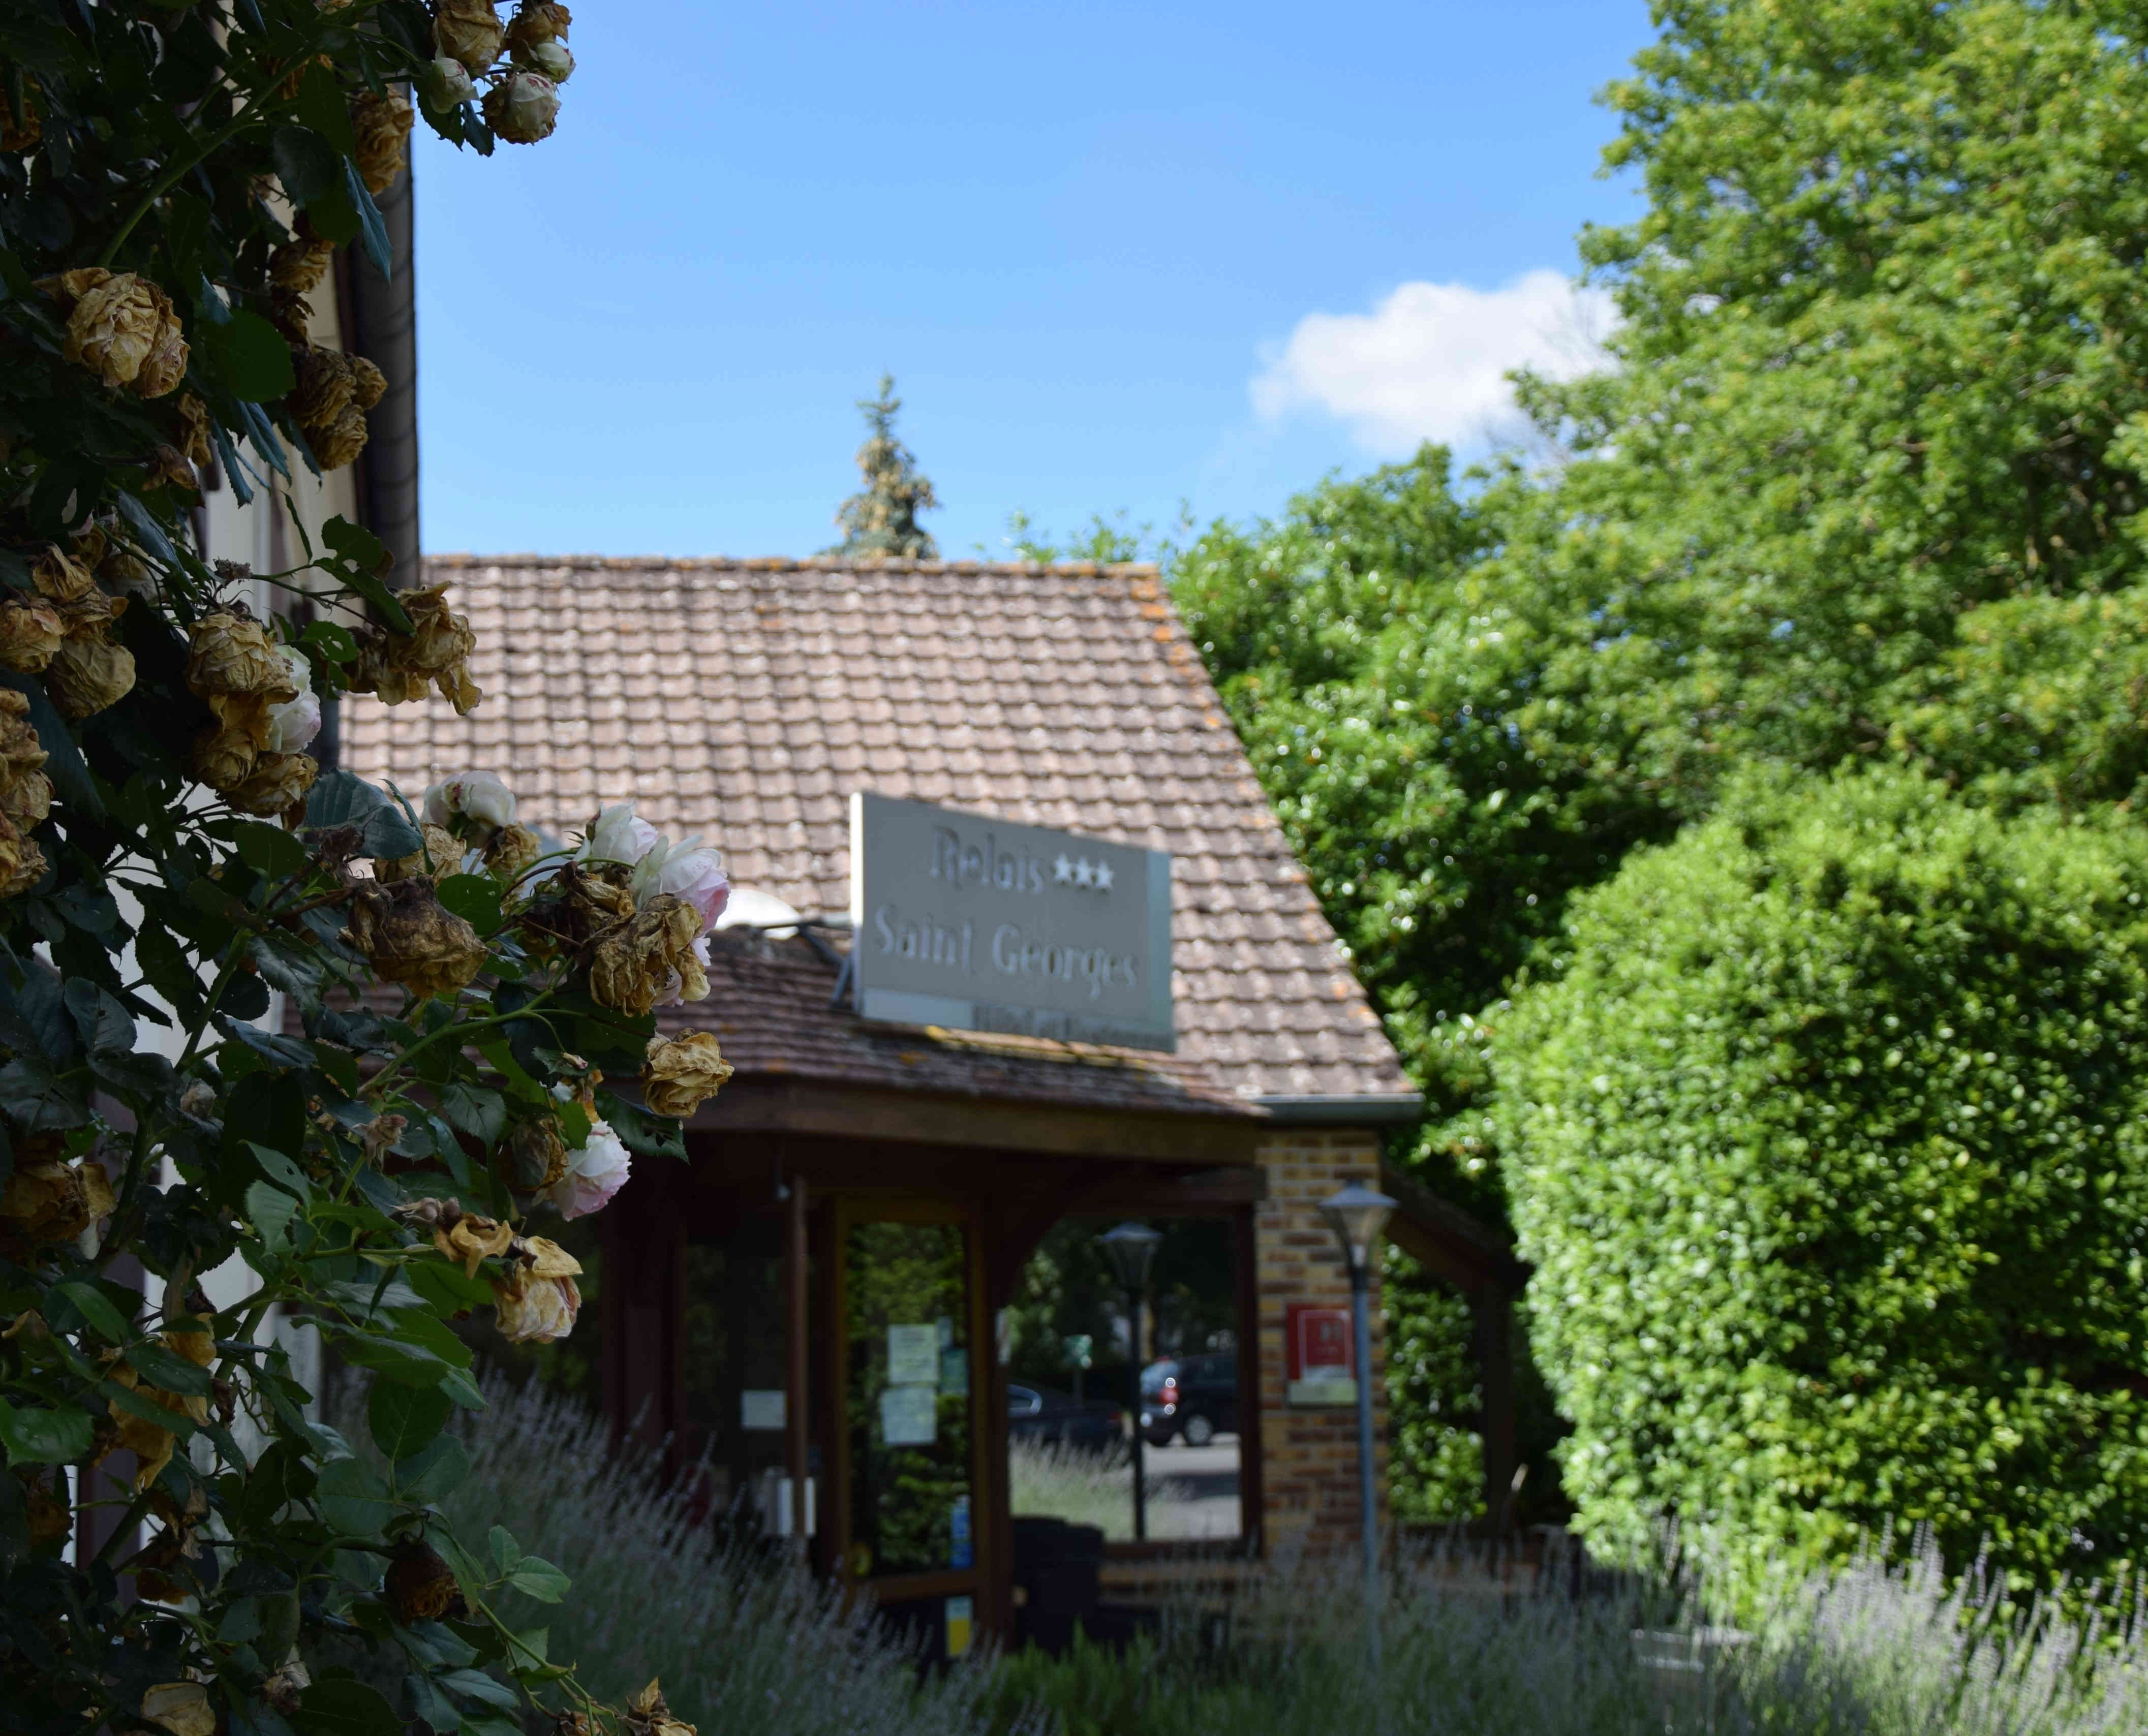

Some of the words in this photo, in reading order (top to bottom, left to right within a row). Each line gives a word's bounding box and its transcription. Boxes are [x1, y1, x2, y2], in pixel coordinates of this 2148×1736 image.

[929, 824, 1045, 895] Relais
[874, 903, 975, 975] Saint
[992, 922, 1140, 1000] Georges
